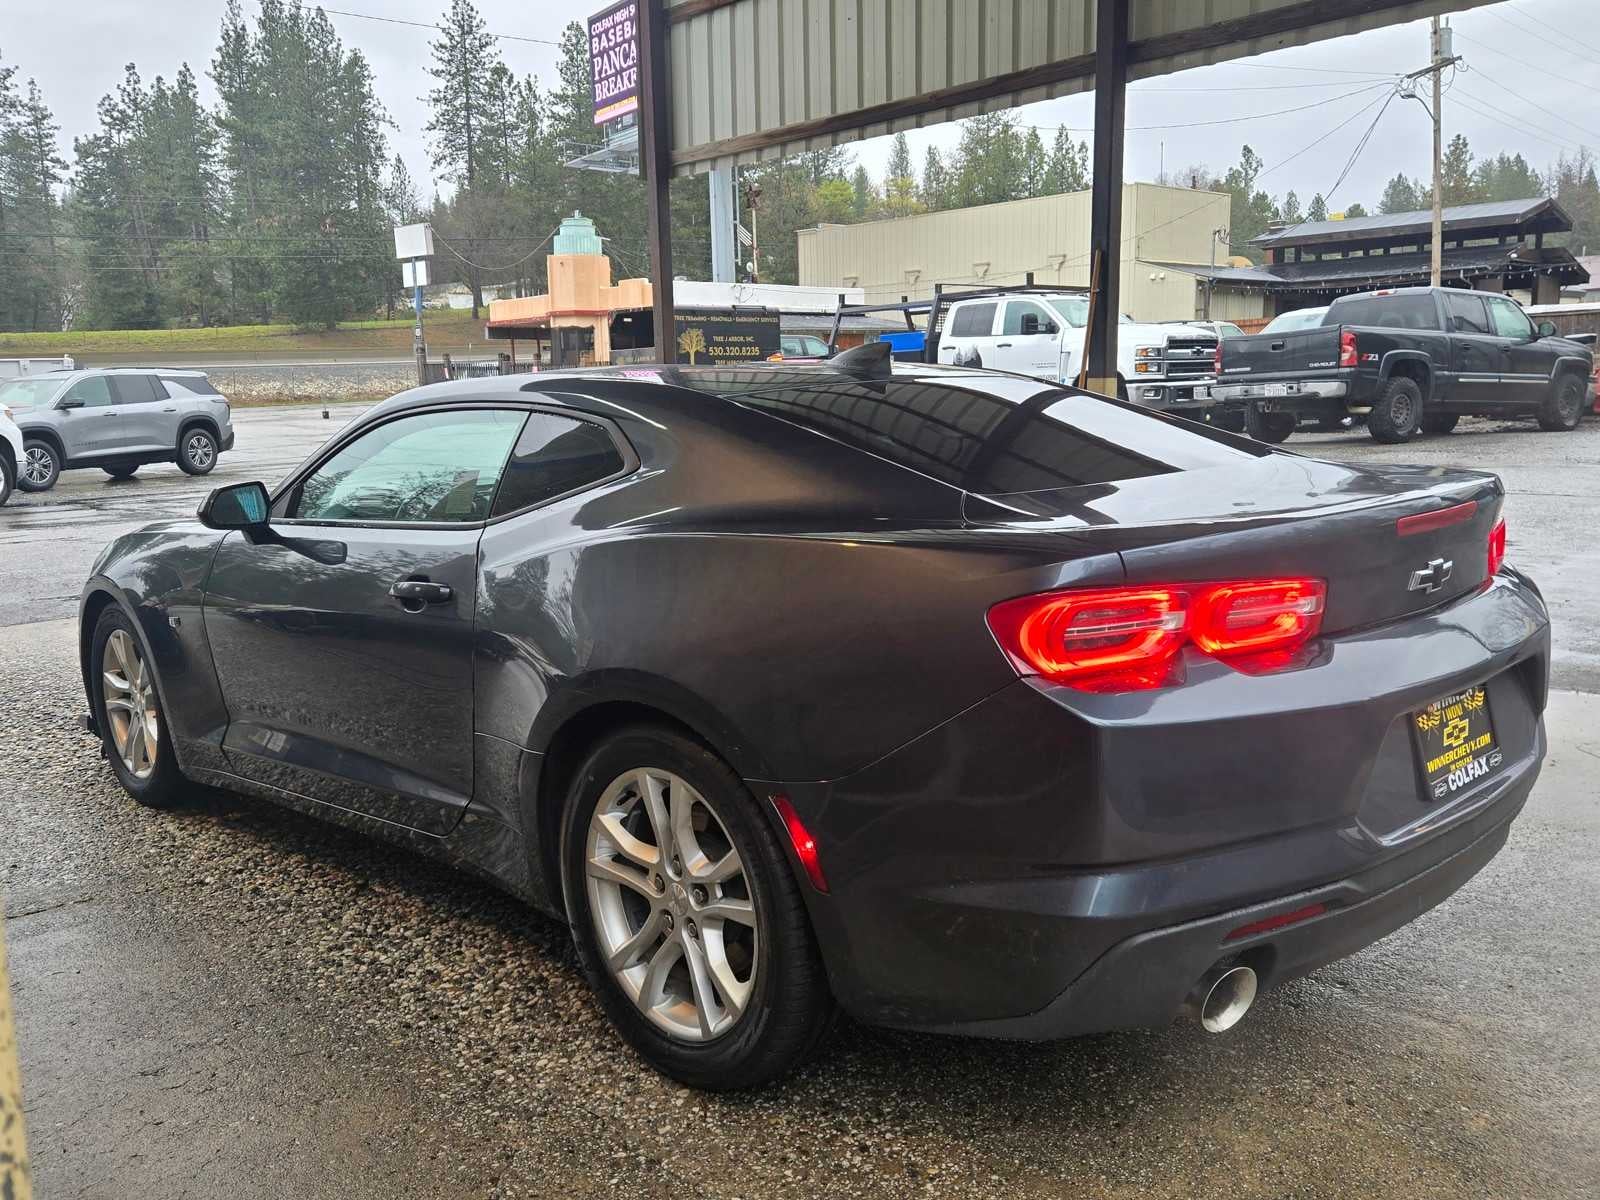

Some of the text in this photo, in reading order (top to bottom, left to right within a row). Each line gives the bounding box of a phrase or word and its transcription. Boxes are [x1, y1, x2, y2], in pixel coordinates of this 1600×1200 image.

[591, 15, 613, 36] COLFAX
[613, 6, 629, 25] HIGH
[593, 39, 637, 80] PANCA
[708, 346, 760, 356] 530.320.8235
[1427, 732, 1491, 773] WINNERCHEVY.COM
[1448, 757, 1489, 791] COLFAX
